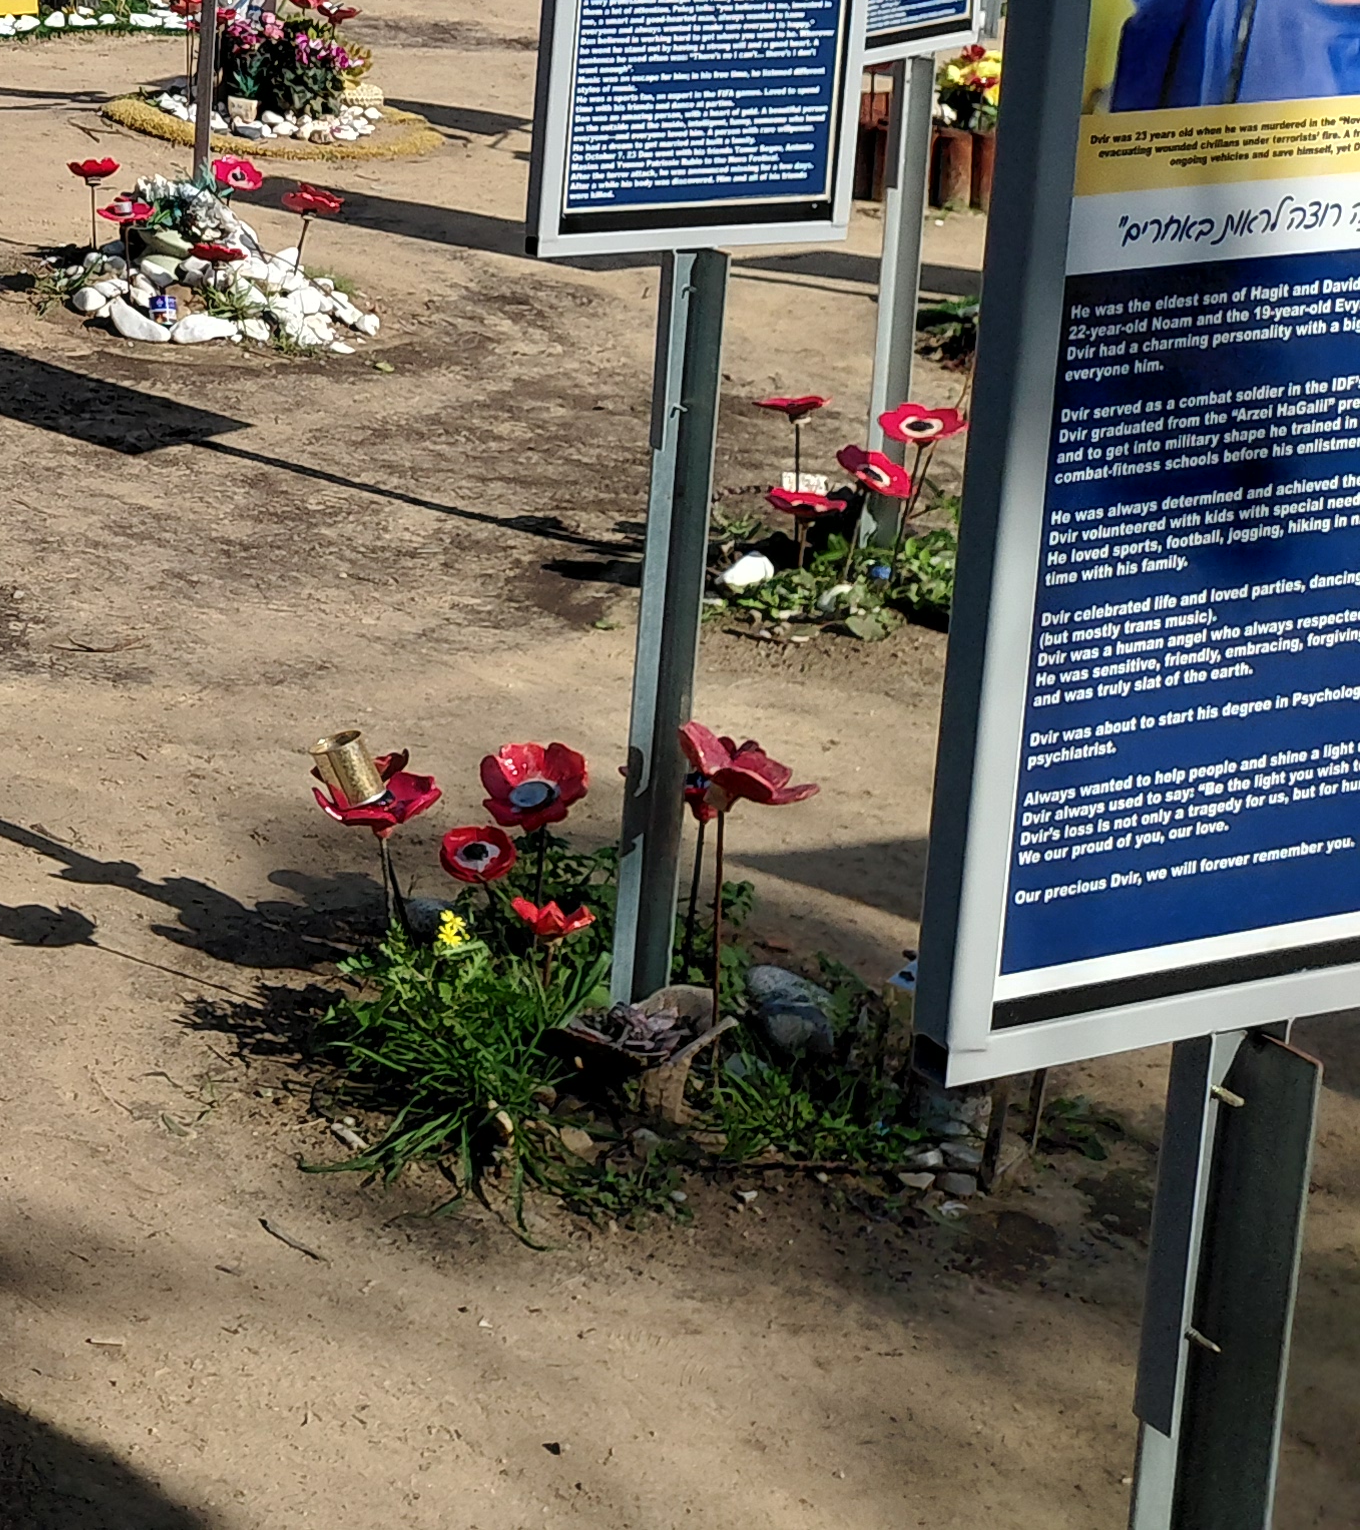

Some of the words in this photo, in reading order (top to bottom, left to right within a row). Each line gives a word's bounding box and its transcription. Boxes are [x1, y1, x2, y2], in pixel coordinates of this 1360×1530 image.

[1090, 133, 1111, 144] Dvir
[1112, 134, 1132, 143] was
[1135, 131, 1147, 141] 23
[1149, 131, 1176, 142] years
[1178, 127, 1194, 137] old
[1196, 126, 1223, 136] when
[1224, 124, 1236, 133] he
[1239, 124, 1258, 132] was
[1260, 119, 1307, 132] murdered
[1309, 118, 1320, 127] in
[1321, 118, 1336, 127] the
[1211, 196, 1294, 245] לראות
[1286, 200, 1342, 231] רוצה
[1071, 305, 1090, 319] He
[1095, 304, 1123, 316] was
[1128, 298, 1150, 313] the
[1156, 294, 1199, 310] eldest
[1203, 292, 1228, 305] son
[1232, 287, 1247, 302] of
[1250, 284, 1289, 302] Hagit
[1292, 280, 1320, 296] and
[1065, 364, 1129, 382] everyone
[1134, 359, 1164, 374] him.
[1059, 427, 1088, 443] Dvir
[1091, 417, 1164, 442] graduated
[1168, 416, 1200, 430] from
[1204, 411, 1228, 425] the
[1039, 630, 1069, 650] (but
[1072, 622, 1121, 642] mostly
[1124, 618, 1161, 634] trans
[1164, 608, 1217, 628] music).
[1033, 689, 1061, 707] and
[1064, 688, 1093, 702] was
[1097, 680, 1131, 697] truly
[1164, 670, 1181, 686] of
[1183, 669, 1207, 684] the
[1210, 662, 1253, 680] earth.
[1027, 740, 1116, 770] psychiatrist.
[1018, 850, 1041, 866] We
[1044, 847, 1069, 861] our
[1071, 836, 1113, 860] proud
[1116, 832, 1132, 848] of
[1134, 831, 1165, 849] you,
[1168, 826, 1193, 839] our
[1196, 821, 1229, 835] love.
[1015, 890, 1042, 904] Our
[1044, 878, 1107, 903] precious
[1110, 871, 1142, 888] Dvir,
[1146, 868, 1167, 882] we
[1170, 860, 1197, 877] will
[1200, 854, 1250, 872] forever
[1252, 842, 1324, 864] remember
[1326, 837, 1355, 854] you.
